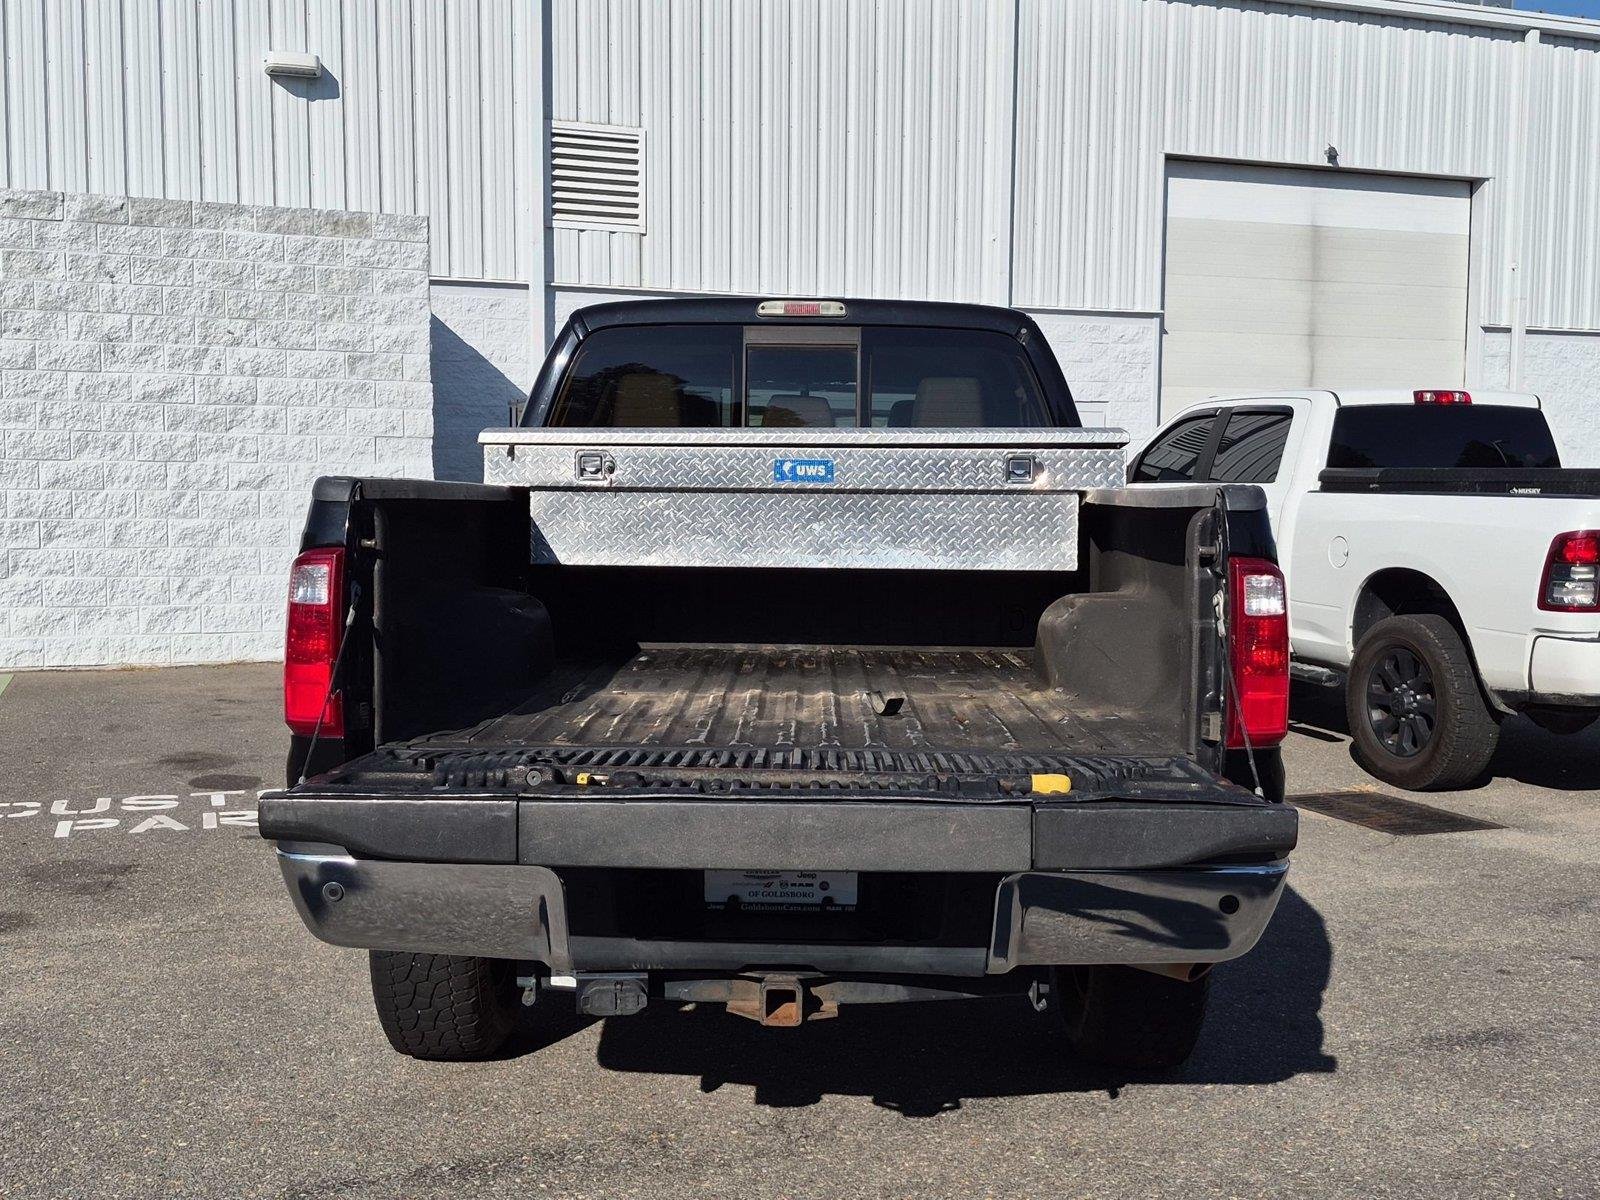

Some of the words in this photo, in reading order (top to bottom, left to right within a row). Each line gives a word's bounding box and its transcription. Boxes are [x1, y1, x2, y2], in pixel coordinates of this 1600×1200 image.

[796, 465, 825, 476] UWS
[1518, 487, 1541, 495] HUSKY
[0, 789, 285, 818] CUST
[797, 871, 817, 880] Jeep
[748, 890, 760, 898] OF
[761, 890, 815, 899] GOLDSBORO
